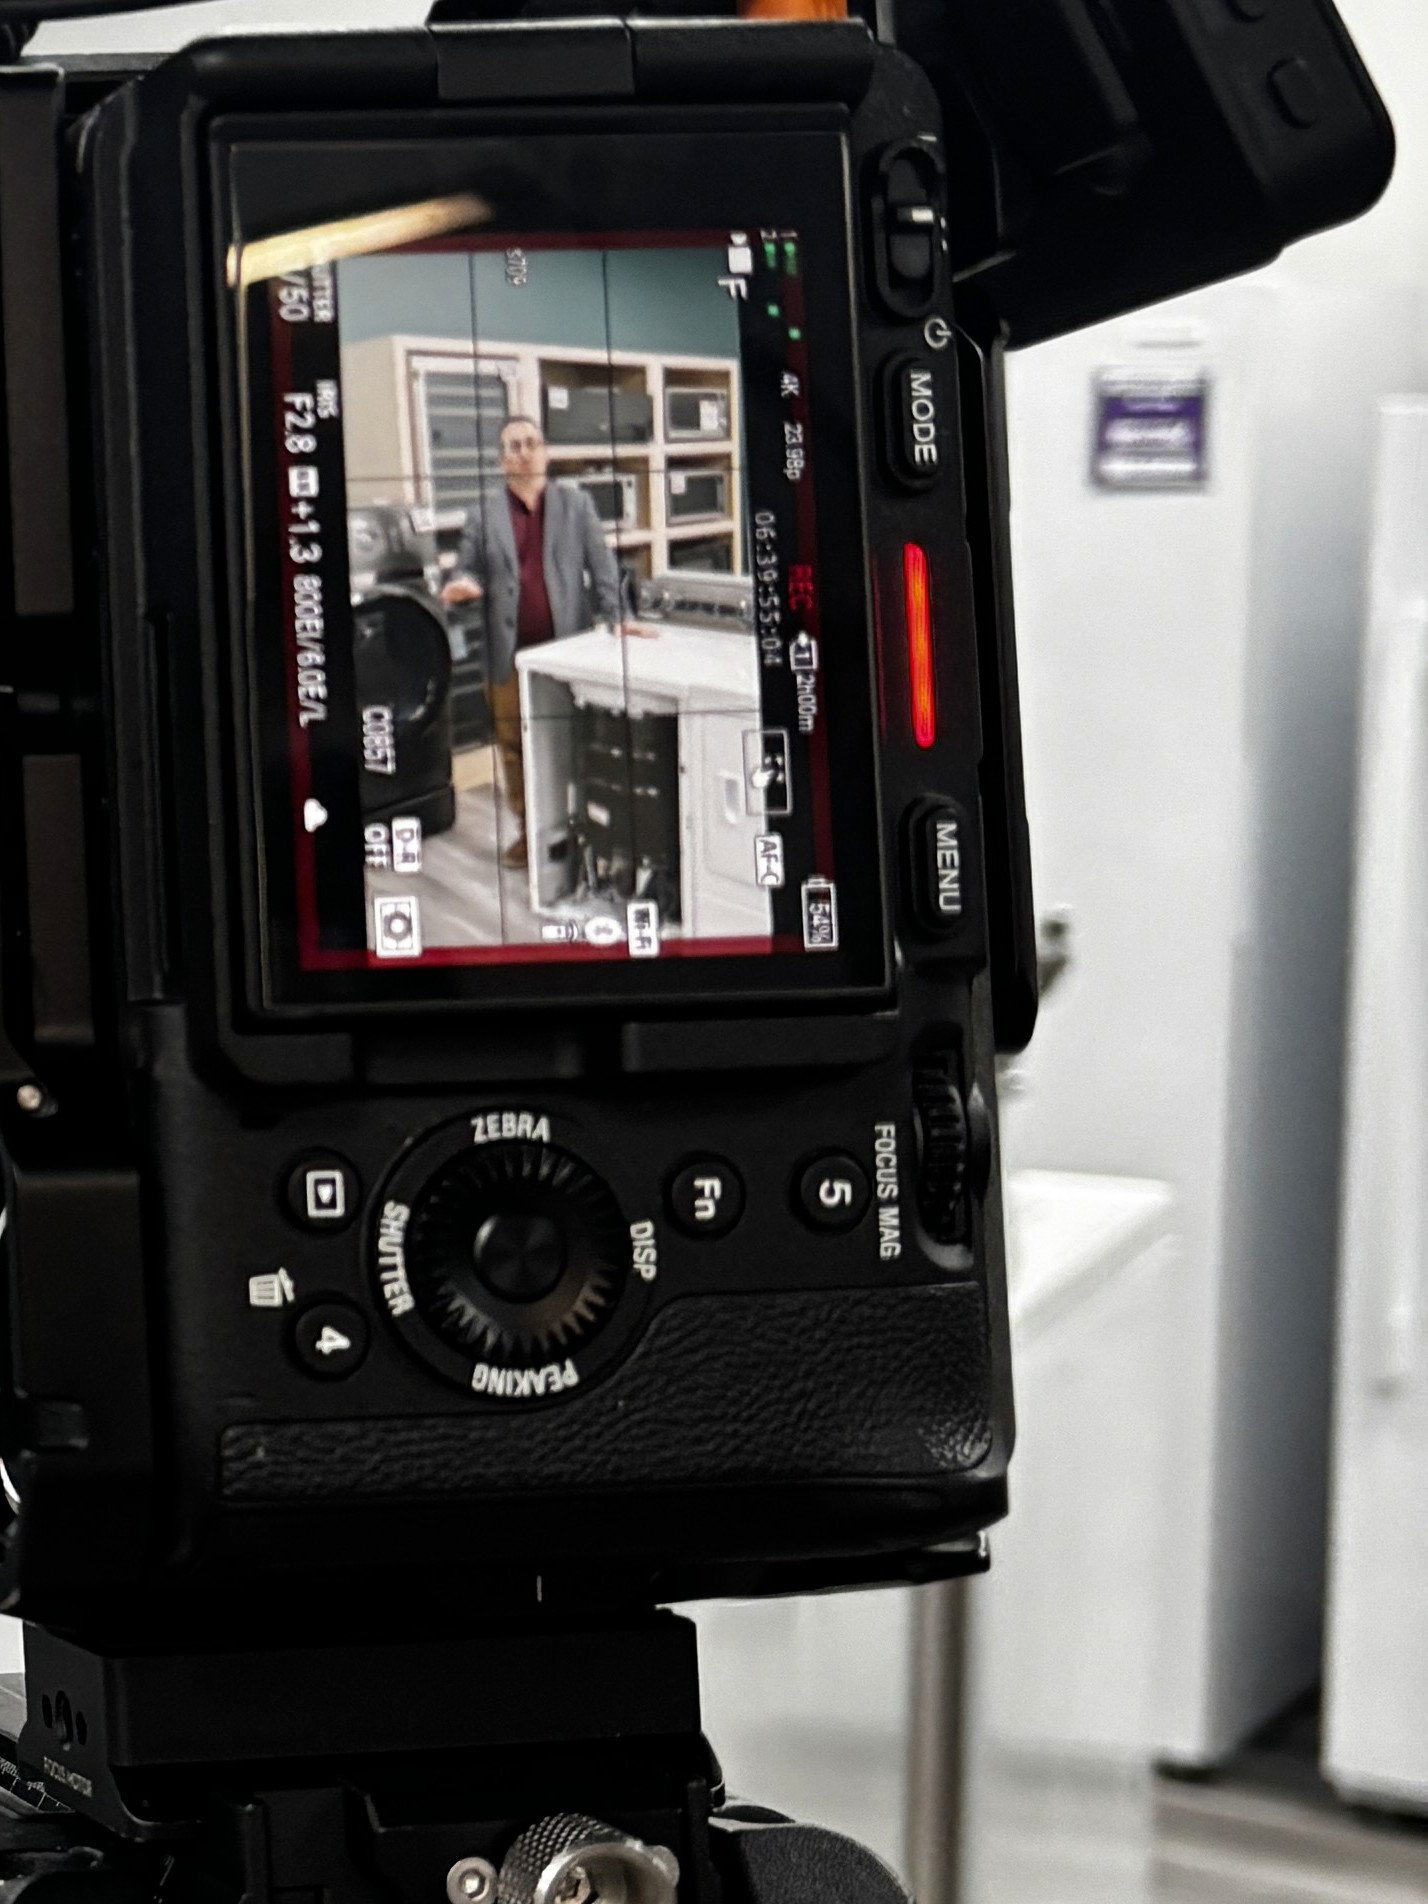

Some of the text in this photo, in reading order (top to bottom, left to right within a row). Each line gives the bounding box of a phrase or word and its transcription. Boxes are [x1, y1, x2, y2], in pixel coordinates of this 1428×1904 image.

[278, 270, 311, 323] /50
[780, 369, 800, 398] 4K
[284, 392, 318, 455] F2.8
[909, 371, 938, 468] MODE
[288, 500, 323, 564] +1.3
[788, 564, 814, 610] REC
[363, 822, 390, 868] OFF
[759, 838, 781, 886] AF-C
[934, 820, 962, 916] MENU
[808, 902, 831, 945] 54%
[470, 1112, 553, 1148] ZEBRA
[691, 1177, 722, 1222] Fn
[816, 1177, 853, 1209] 5
[872, 1122, 903, 1261] FOCUS MAG
[374, 1200, 416, 1319] SHUTTER
[627, 1218, 657, 1284] DISP
[312, 1326, 352, 1356] 4
[470, 1359, 581, 1399] PEAKING
